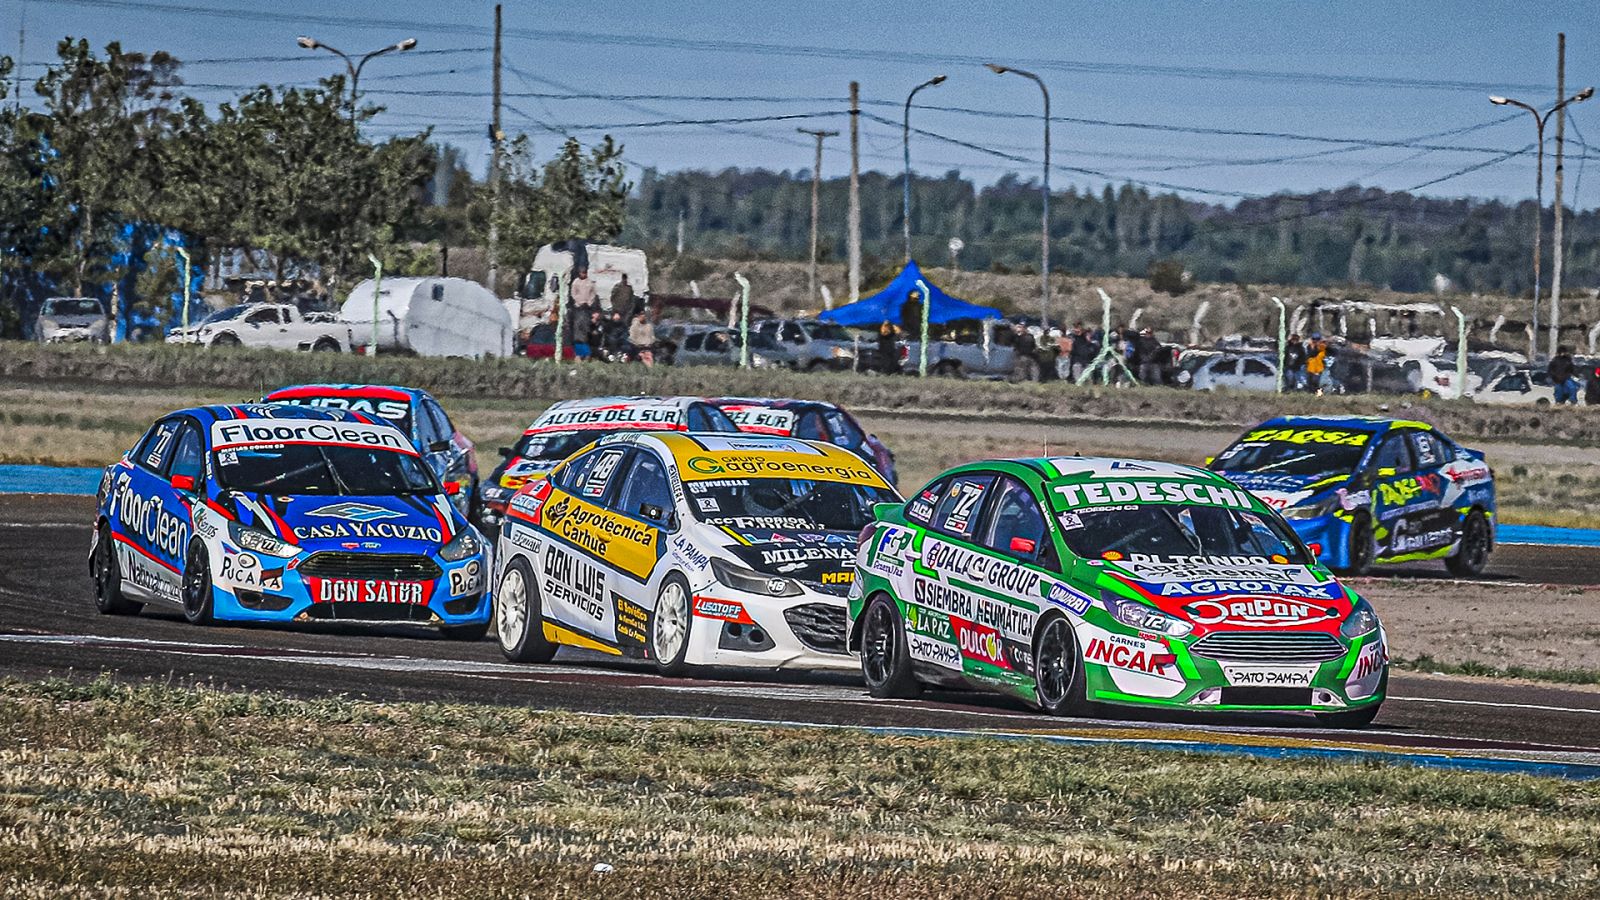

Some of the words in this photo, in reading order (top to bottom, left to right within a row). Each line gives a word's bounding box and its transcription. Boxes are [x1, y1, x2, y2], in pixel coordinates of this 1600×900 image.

[544, 411, 603, 425] AUTOS
[604, 409, 637, 422] DEL
[639, 409, 677, 423] SUR
[753, 413, 788, 428] SUR
[220, 424, 402, 448] FloorClean
[592, 453, 621, 480] 48
[725, 460, 872, 481] agroenergía
[953, 486, 981, 517] 72
[1054, 481, 1253, 509] TEDESCHI
[109, 473, 187, 562] FloorClean
[1074, 505, 1123, 515] TEDESCHI
[293, 524, 351, 540] CASA
[348, 522, 442, 543] YACUZIO
[568, 504, 653, 546] Agrotécnica
[673, 534, 686, 550] LA
[685, 543, 711, 571] PAMPA
[762, 547, 859, 565] MILENA
[544, 544, 574, 588] DON
[574, 559, 606, 603] LUIS
[988, 562, 1040, 596] GROUP
[320, 579, 359, 602] DON
[364, 579, 425, 604] SATUR
[768, 579, 787, 593] 48
[1161, 579, 1332, 598] AGROTAX
[543, 580, 605, 622] SERVICIOS
[926, 583, 973, 619] SIEMBRA
[976, 599, 1033, 638] NEUMÁTICA
[917, 613, 931, 632] LA
[931, 619, 951, 639] PAZ
[1144, 614, 1166, 629] 72
[1109, 635, 1147, 649] CARNES
[1233, 672, 1264, 684] PATO
[1265, 672, 1309, 685] PAMPA
